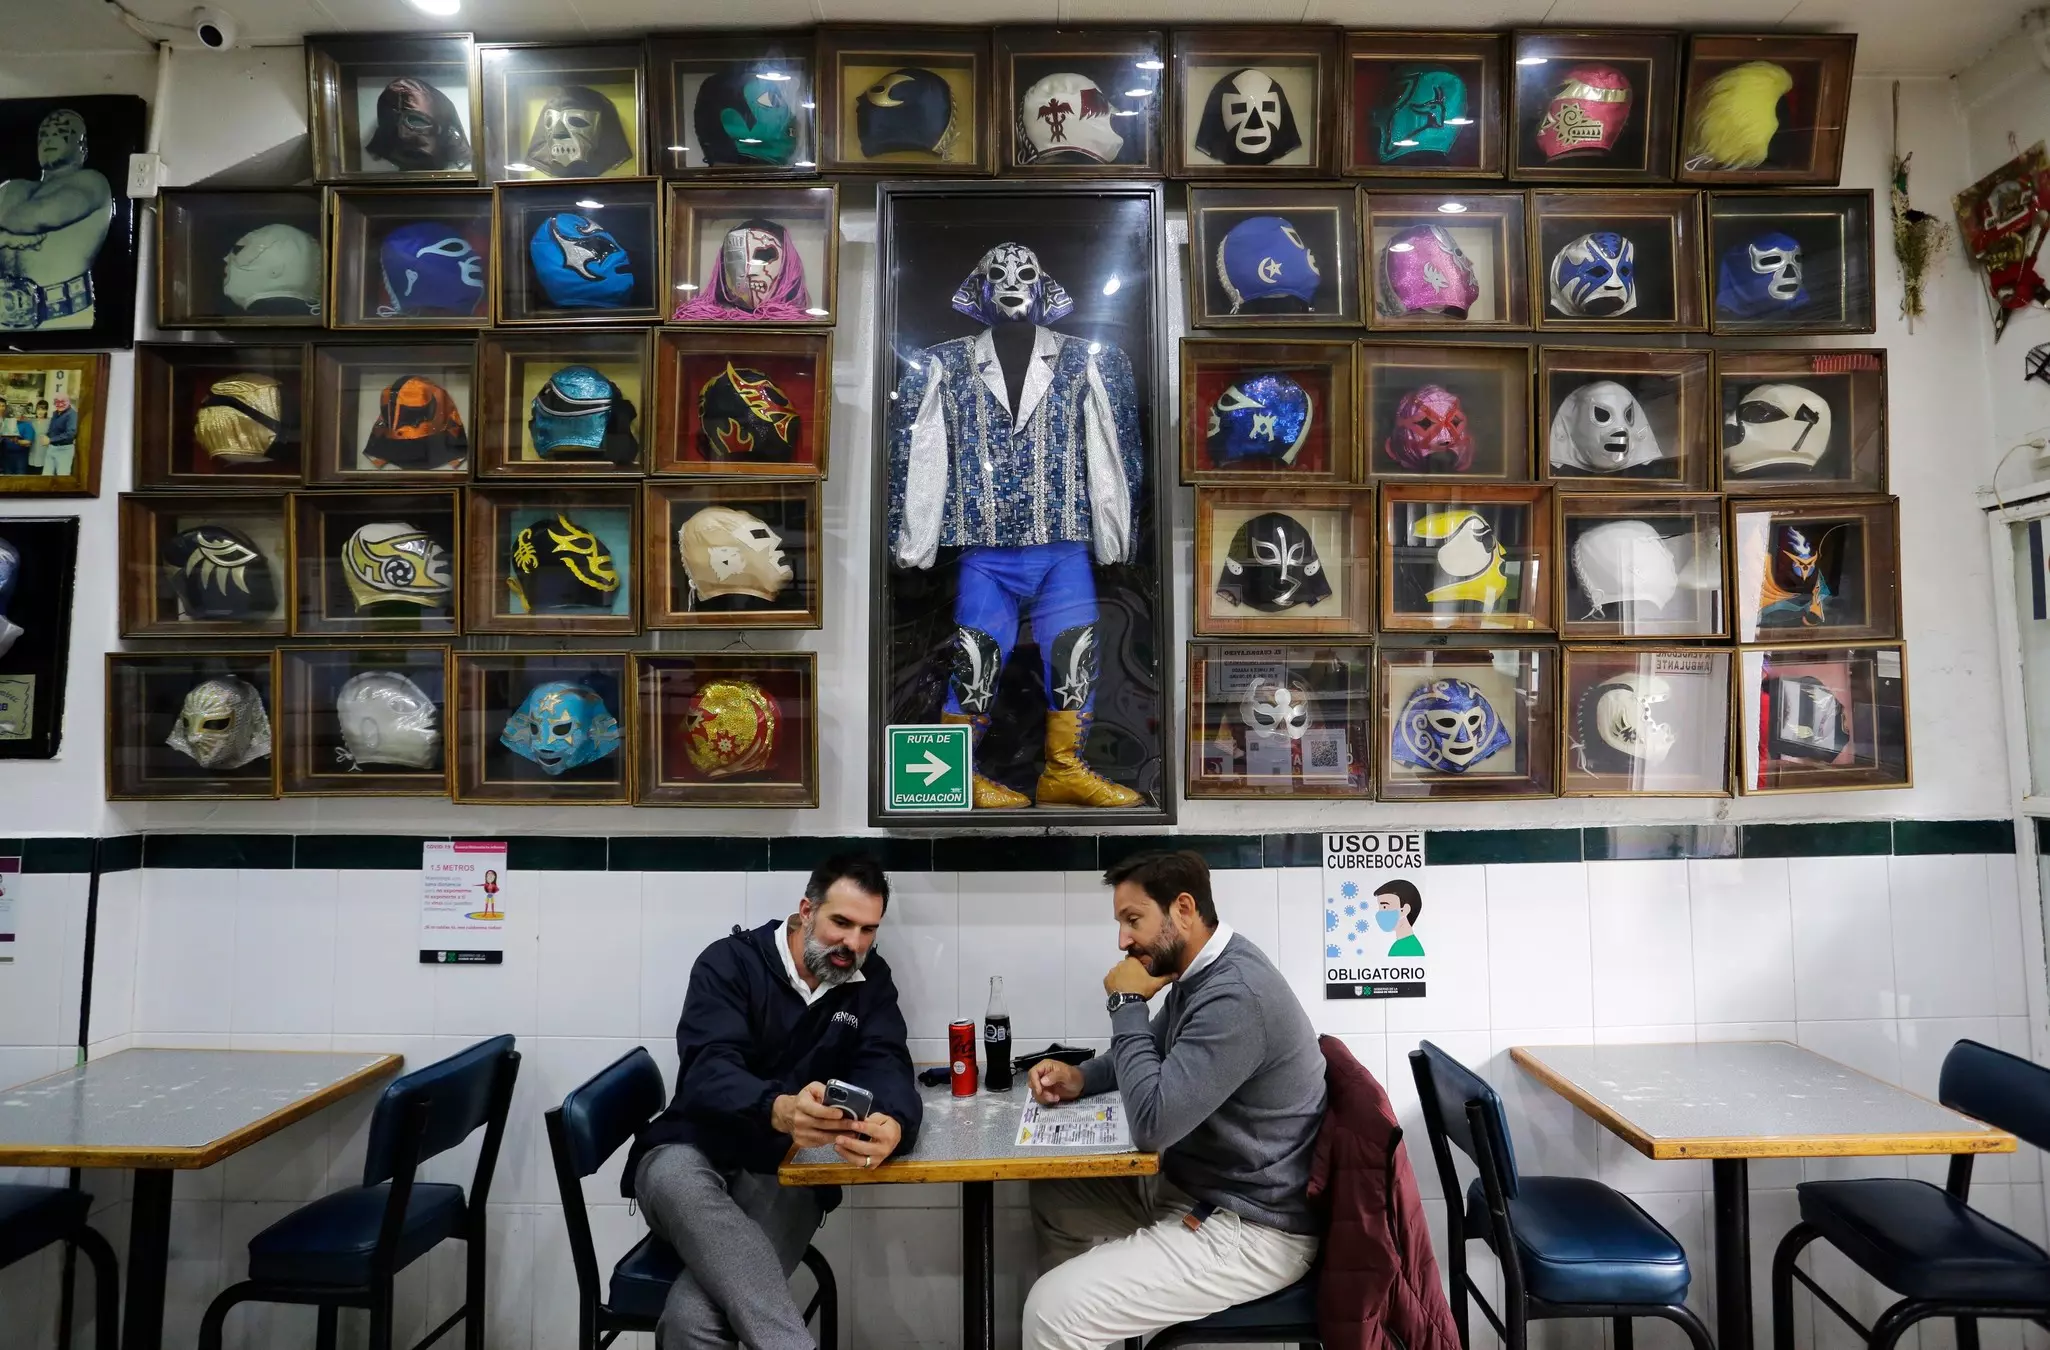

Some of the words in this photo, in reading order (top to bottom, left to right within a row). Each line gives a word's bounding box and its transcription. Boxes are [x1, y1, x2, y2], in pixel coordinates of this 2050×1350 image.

[907, 735, 933, 743] RUTA
[937, 735, 950, 743] DE
[895, 794, 962, 803] EVACUACION
[1328, 835, 1380, 853] USO
[1388, 834, 1420, 852] DE
[1327, 854, 1422, 869] CUBREBOCAS
[442, 864, 475, 872] METROS
[1327, 967, 1425, 981] OBLIGATORIO
